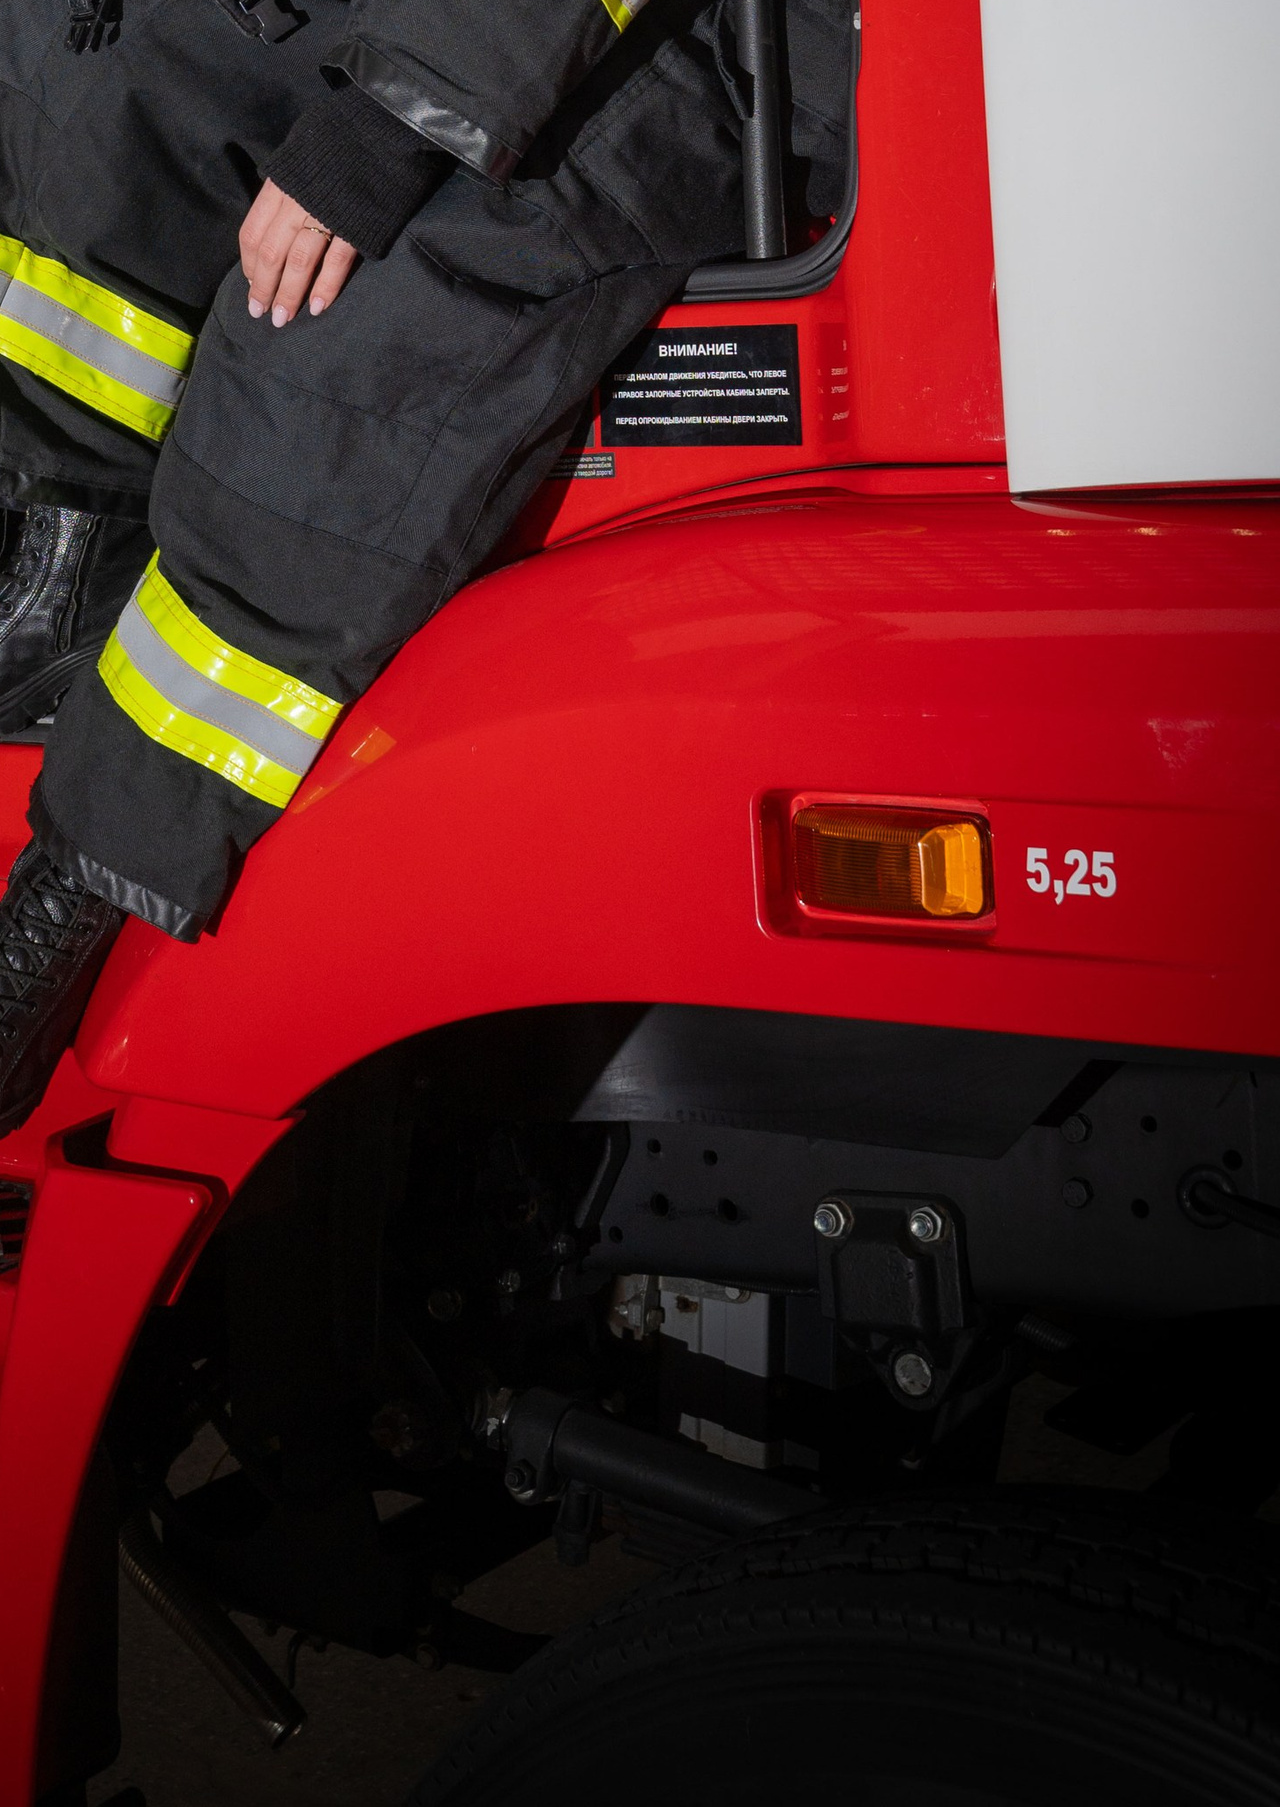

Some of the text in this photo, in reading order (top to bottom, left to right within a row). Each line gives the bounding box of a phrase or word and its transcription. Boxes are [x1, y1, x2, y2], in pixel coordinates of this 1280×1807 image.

[658, 342, 738, 358] ВНИМАНИЕ!
[613, 369, 787, 382] ПЕРЕД НАЧАЛОМ ДВИЖЕНИЯ УБЕДИТЕСЬ, ЧТО ЛЕВОЕ
[618, 390, 644, 399] ПРАВОЕ
[644, 389, 682, 399] ЗАПОРНЫЕ
[682, 388, 725, 398] УСТРОЙСТВА
[725, 388, 755, 397] КАБИНЫ
[755, 387, 790, 396] ЗАПЕРТЫ.
[615, 414, 789, 426] ПЕРЕД ОПРОКИДЫВАНИЕМ КАБИНЫ ДВЕРИ ЗАКРЫТЬ
[1025, 846, 1118, 906] 5,25
